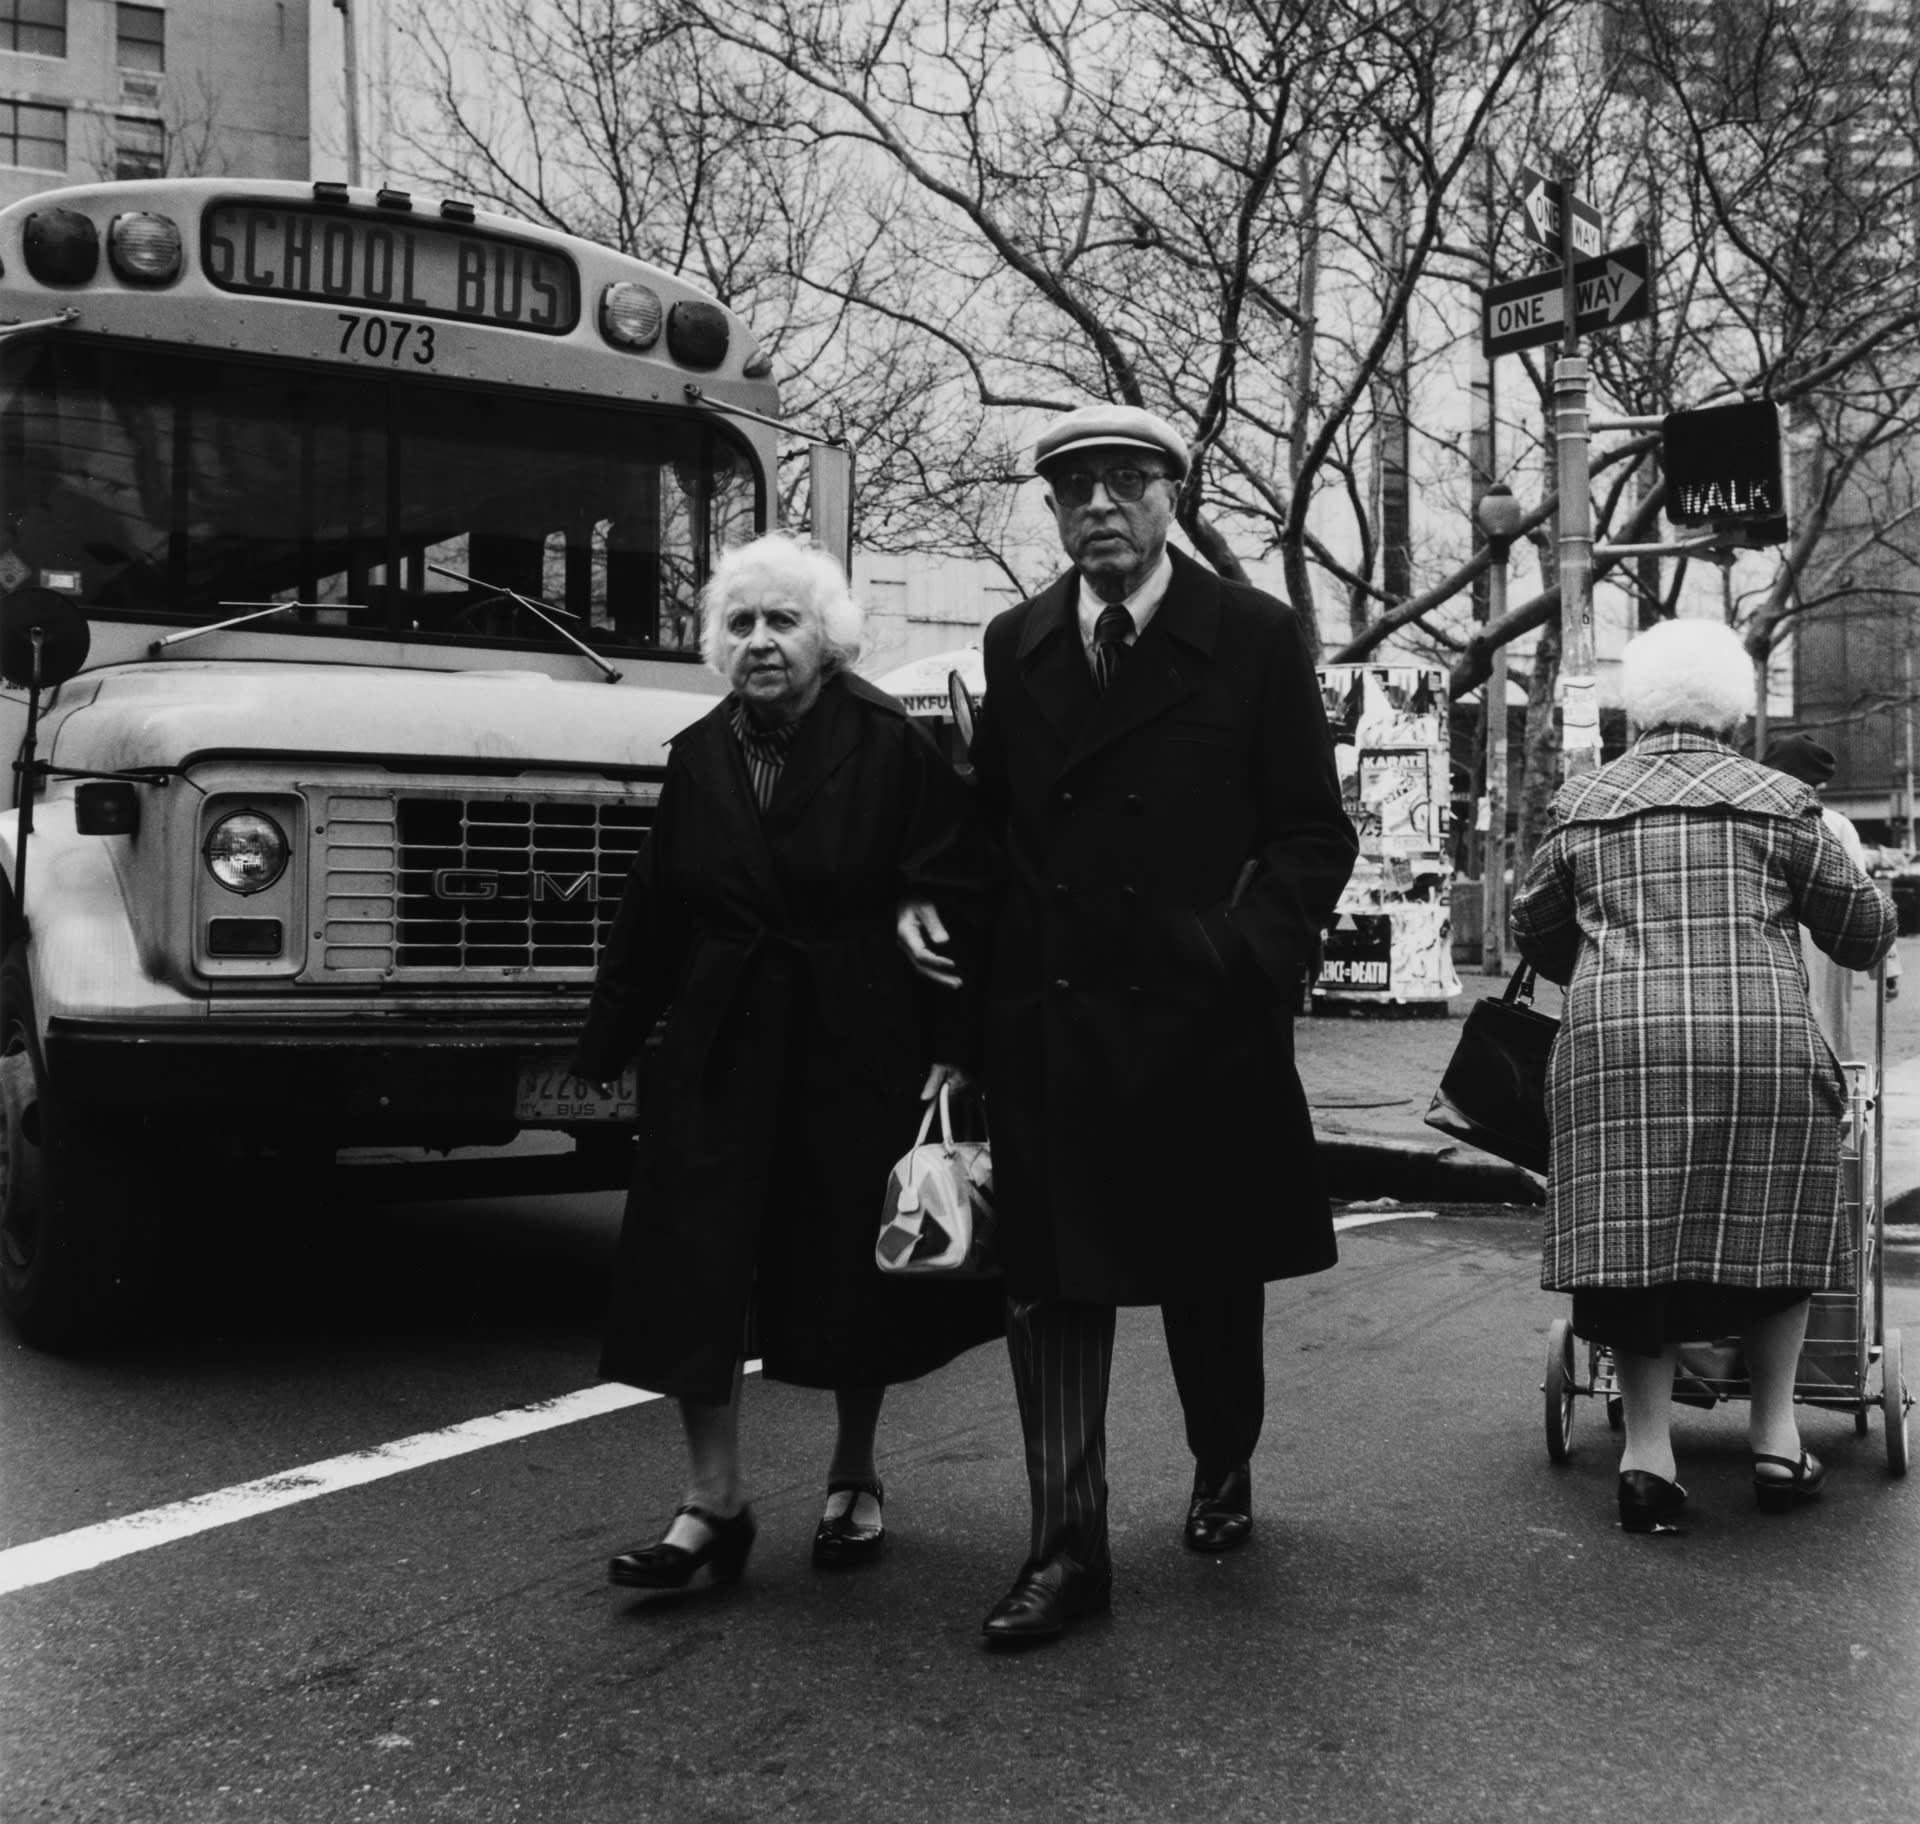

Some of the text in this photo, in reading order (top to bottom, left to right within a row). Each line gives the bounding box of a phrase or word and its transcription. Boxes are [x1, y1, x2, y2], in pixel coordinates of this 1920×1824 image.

[1535, 196, 1598, 254] ONE WAY
[209, 209, 558, 325] SCHOOL BUS
[1497, 273, 1625, 333] ONE WAY
[337, 314, 436, 365] 7073
[1679, 480, 1771, 516] WALK
[1362, 755, 1426, 769] KARATE
[557, 1103, 596, 1116] BUS
